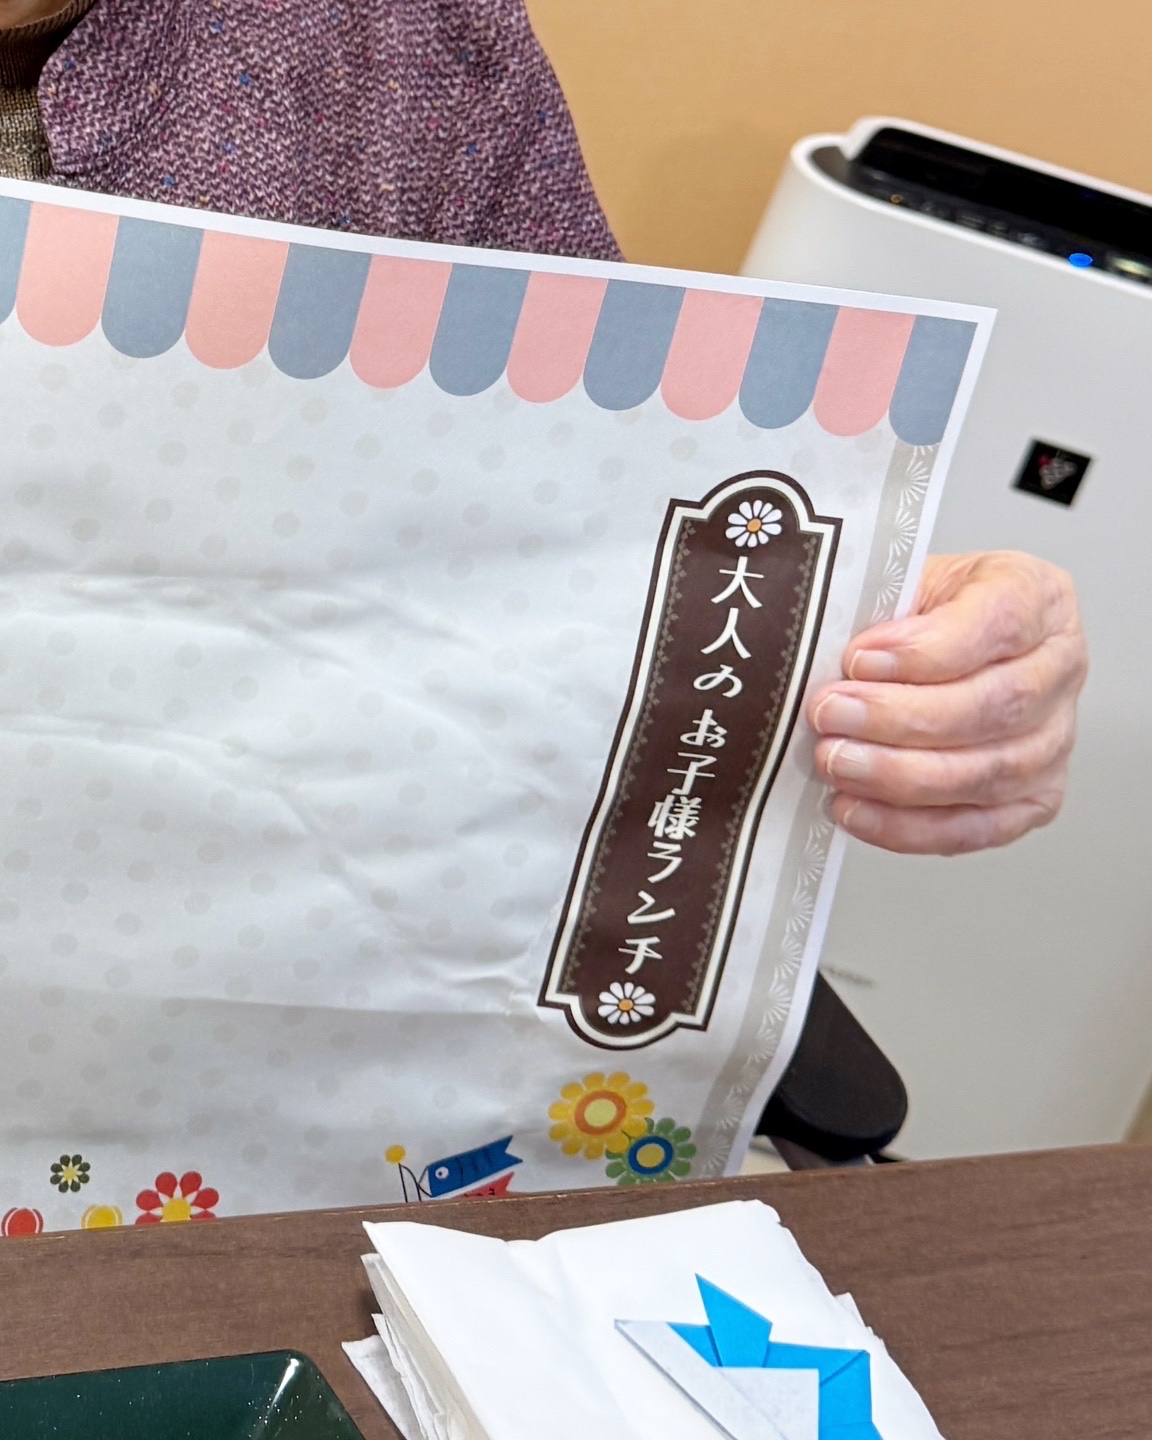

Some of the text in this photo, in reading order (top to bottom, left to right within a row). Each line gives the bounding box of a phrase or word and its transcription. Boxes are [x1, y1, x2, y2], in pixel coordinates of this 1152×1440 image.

[618, 556, 764, 975] 大人のお子様ランチ
